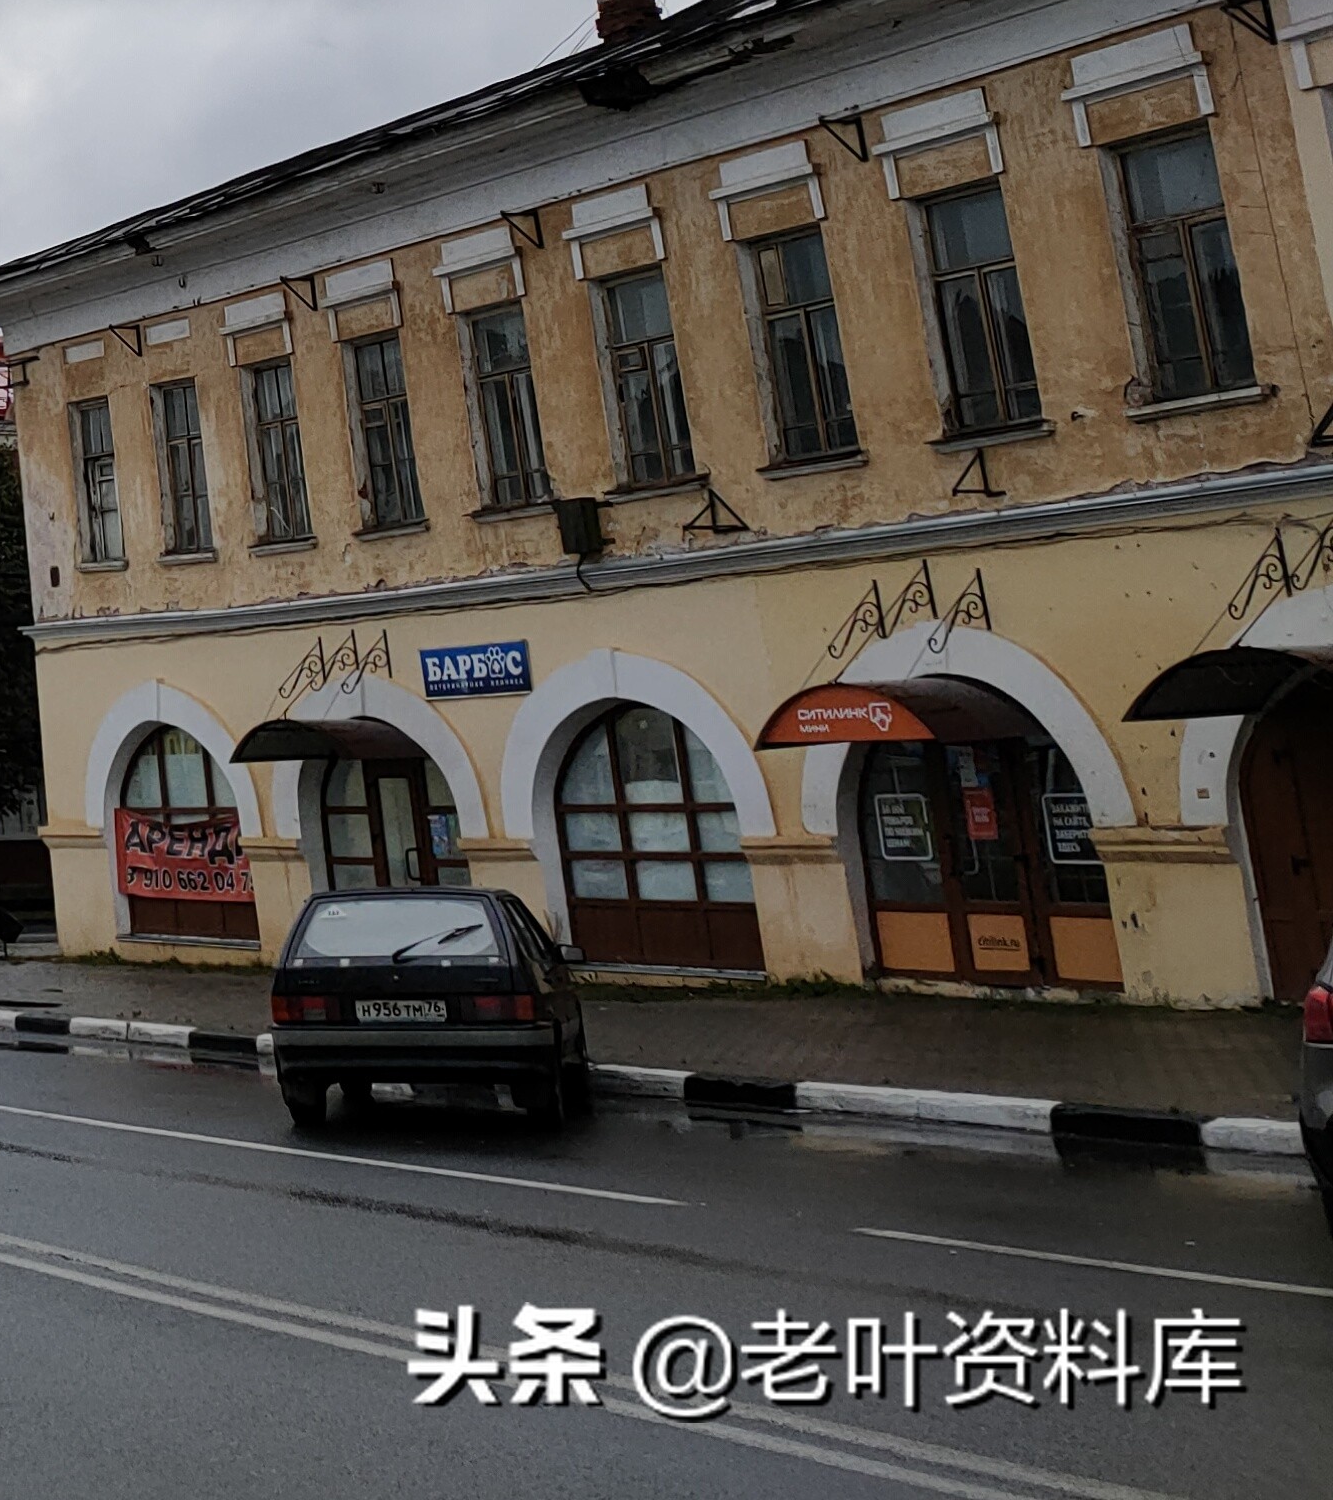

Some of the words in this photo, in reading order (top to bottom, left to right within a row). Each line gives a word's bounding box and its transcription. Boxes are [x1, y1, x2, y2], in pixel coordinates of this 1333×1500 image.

[797, 707, 869, 721] СИТИЛИНК
[799, 724, 830, 733] МИНИ
[143, 868, 173, 890] 910
[176, 867, 211, 892] 662
[213, 869, 236, 893] 04
